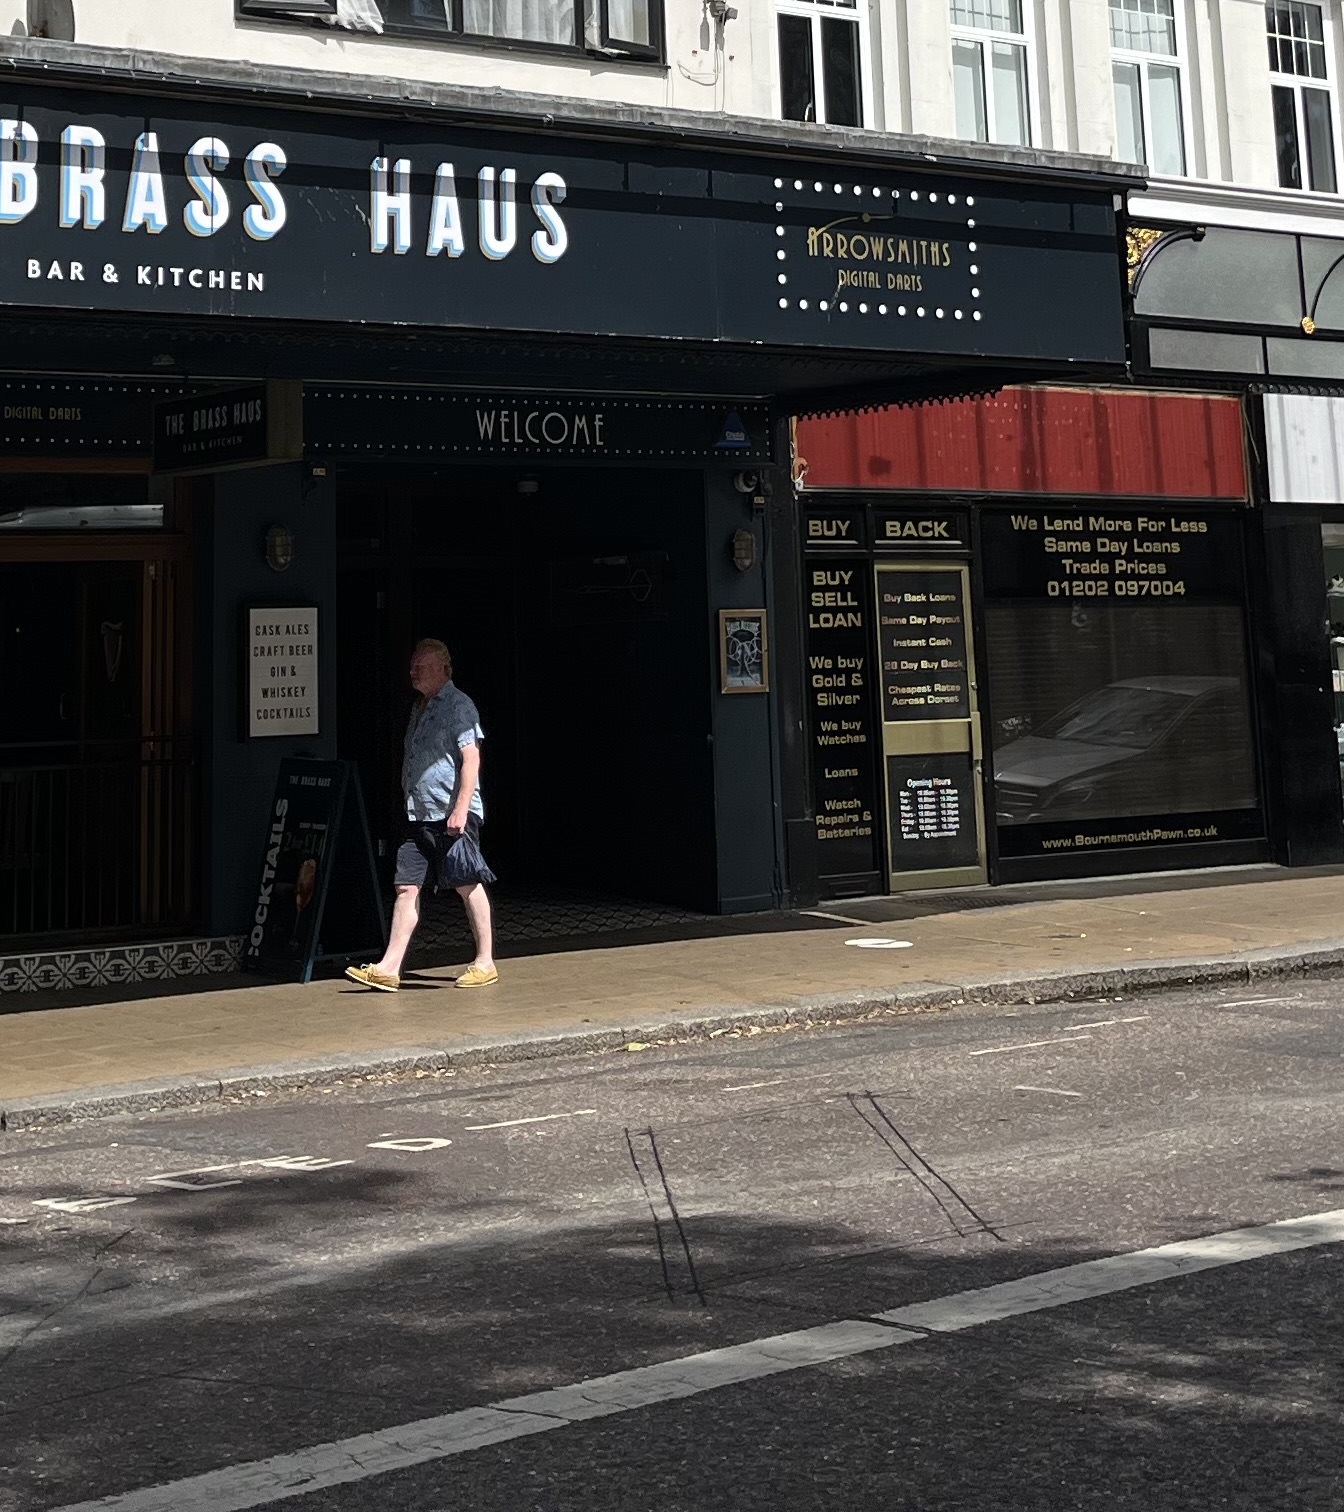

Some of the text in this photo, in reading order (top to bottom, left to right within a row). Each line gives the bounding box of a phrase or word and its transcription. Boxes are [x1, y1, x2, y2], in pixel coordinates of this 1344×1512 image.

[371, 156, 569, 263] HAUS
[807, 226, 952, 268] ARROWSMITHS
[27, 259, 265, 292] BAR & KITCHEN
[838, 268, 923, 293] DIGITAL DARTS
[3, 405, 81, 421] DIGITAL DARTS
[164, 398, 262, 437] THE BRASS HAUS
[476, 408, 605, 447] WELCOME
[808, 520, 950, 537] BUY BACK
[1011, 515, 1208, 533] We Lend More For Less
[1044, 537, 1180, 555] Same Day Loans
[1061, 559, 1167, 574] Trade Prices
[813, 570, 853, 585] BUY
[1047, 581, 1186, 596] 01202 097004
[811, 592, 858, 606] SELL
[883, 593, 956, 604] Buy Back Loans
[809, 612, 862, 628] LOAN
[881, 615, 960, 625] Same Day Payout
[255, 624, 309, 636] CASK ALES
[893, 638, 952, 647] Instant Cash
[253, 645, 313, 657] CRAFT BEER
[809, 655, 864, 670] We buy
[900, 661, 919, 671] Day
[920, 660, 939, 670] Buy
[941, 659, 963, 668] Back
[270, 665, 297, 678] GIN &
[812, 673, 864, 688] Gold &
[261, 686, 306, 698] WHISKEY
[888, 683, 961, 695] Cheapest Rates
[817, 693, 861, 706] Silver
[891, 694, 959, 705] Across Dorset
[256, 707, 311, 720] COCKTAILS
[821, 720, 862, 731] We buy
[817, 734, 866, 746] Watches
[825, 768, 858, 778] Loans
[825, 798, 861, 810] Watch
[816, 811, 873, 826] Repairs &
[817, 826, 872, 840] Batteries
[1042, 825, 1218, 849] www.BournemouthPawn.co.uk
